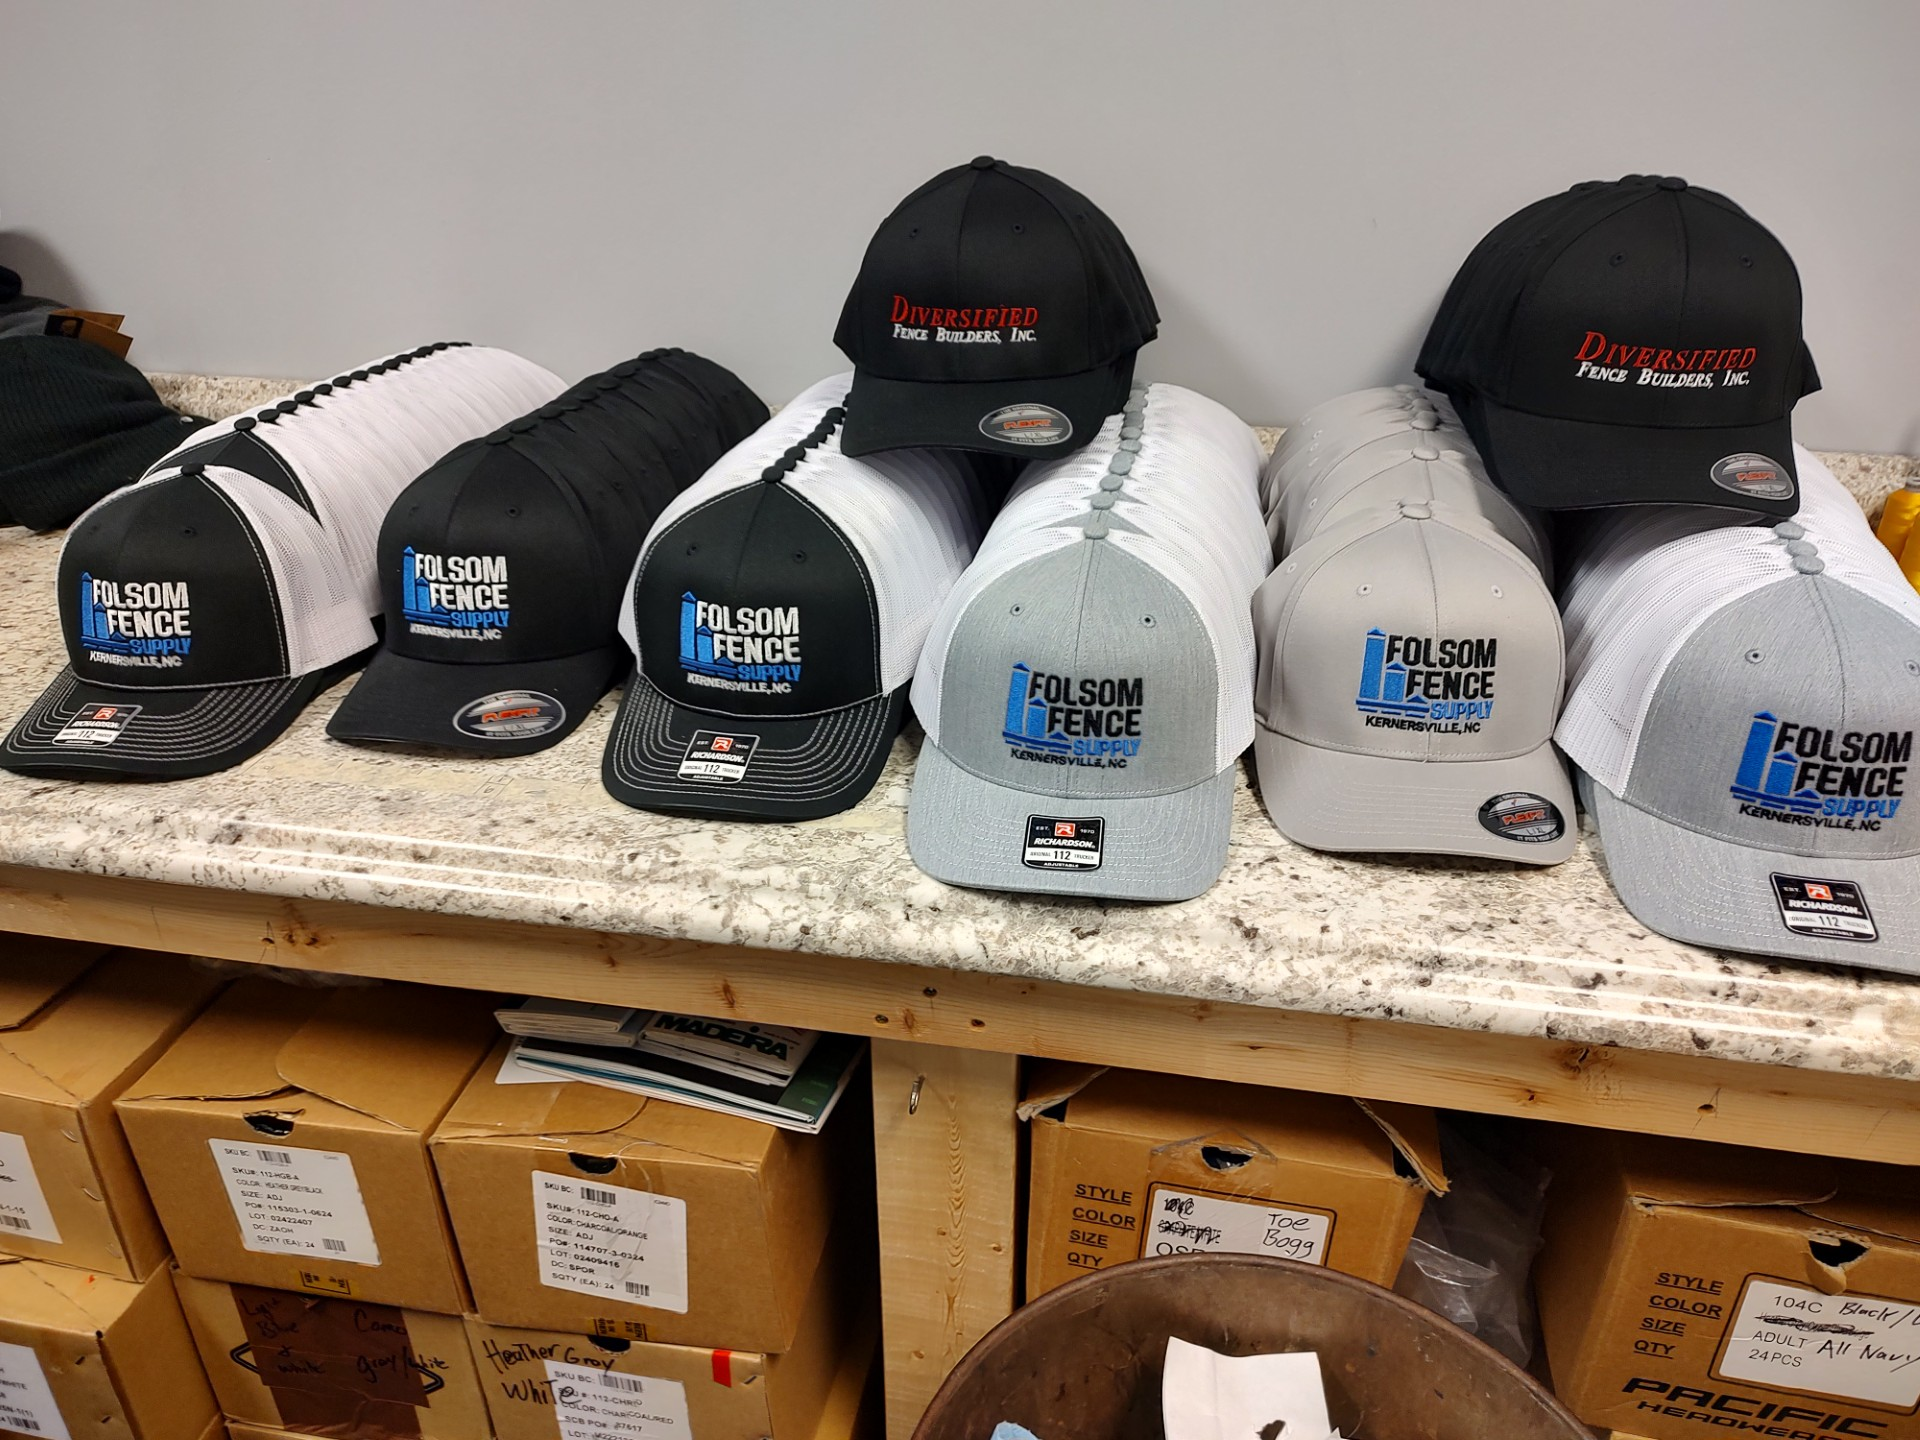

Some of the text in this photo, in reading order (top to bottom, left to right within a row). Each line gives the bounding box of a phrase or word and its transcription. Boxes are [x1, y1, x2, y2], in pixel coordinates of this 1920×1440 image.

[893, 323, 929, 341] FENCE
[935, 327, 1002, 344] BUILDERS,
[1575, 361, 1628, 383] FENCE
[1637, 367, 1714, 389] BUILDERS,
[415, 553, 508, 583] FOLSOM
[93, 579, 189, 609] FOLSOM
[430, 582, 510, 610] FENCE
[107, 609, 191, 637] FENCE
[451, 611, 509, 628] SUPPLY
[696, 600, 799, 635] FOLSOM
[130, 638, 191, 655] SUPPLY
[713, 633, 801, 663] FENCE
[1386, 635, 1497, 669] FOLSOM
[738, 665, 800, 681] SUPPLY
[1029, 671, 1143, 707] FOLSOM
[1405, 669, 1495, 700] FENCE
[1430, 700, 1494, 720] SUPPLY
[1048, 706, 1142, 737] FENCE
[1464, 722, 1481, 733] NC
[78, 730, 95, 738] 112
[1773, 721, 1913, 764] FOLSOM
[1073, 738, 1142, 757] SUPPLY
[703, 764, 720, 774] 112
[1108, 759, 1127, 768] NC
[1794, 761, 1907, 797] FENCE
[1739, 803, 1881, 832] KERNERSVILLE, NC
[1822, 798, 1901, 819] SUPPLY
[1034, 838, 1094, 849] RICHARDSON
[1053, 850, 1071, 860] 112
[1818, 915, 1841, 927] 112
[241, 1190, 263, 1198] SIZE:
[544, 1182, 574, 1193] SKU BC:
[1076, 1183, 1132, 1203] STYLE
[1073, 1207, 1136, 1227] COLOR
[1267, 1213, 1310, 1231] Toe
[548, 1226, 593, 1241] SIZE: ADJ
[1070, 1230, 1108, 1246] SIZE
[550, 1249, 571, 1258] LOT:
[1067, 1252, 1103, 1267] QTY
[551, 1260, 595, 1275] DC: SPOR
[552, 1272, 614, 1290] SQTY (EA): 24
[1657, 1272, 1724, 1293] STYLE
[1649, 1295, 1723, 1317] COLOR
[1774, 1295, 1823, 1314] 104C
[1641, 1317, 1687, 1334] SIZE
[1634, 1340, 1676, 1355] QTY
[1752, 1330, 1808, 1349] ADULT
[1816, 1339, 1852, 1359] All
[554, 1371, 595, 1384] SKU BC:
[561, 1402, 600, 1414] COLOR:
[1622, 1377, 1889, 1439] PACIFIC
[1636, 1401, 1842, 1440] HEADWEA
